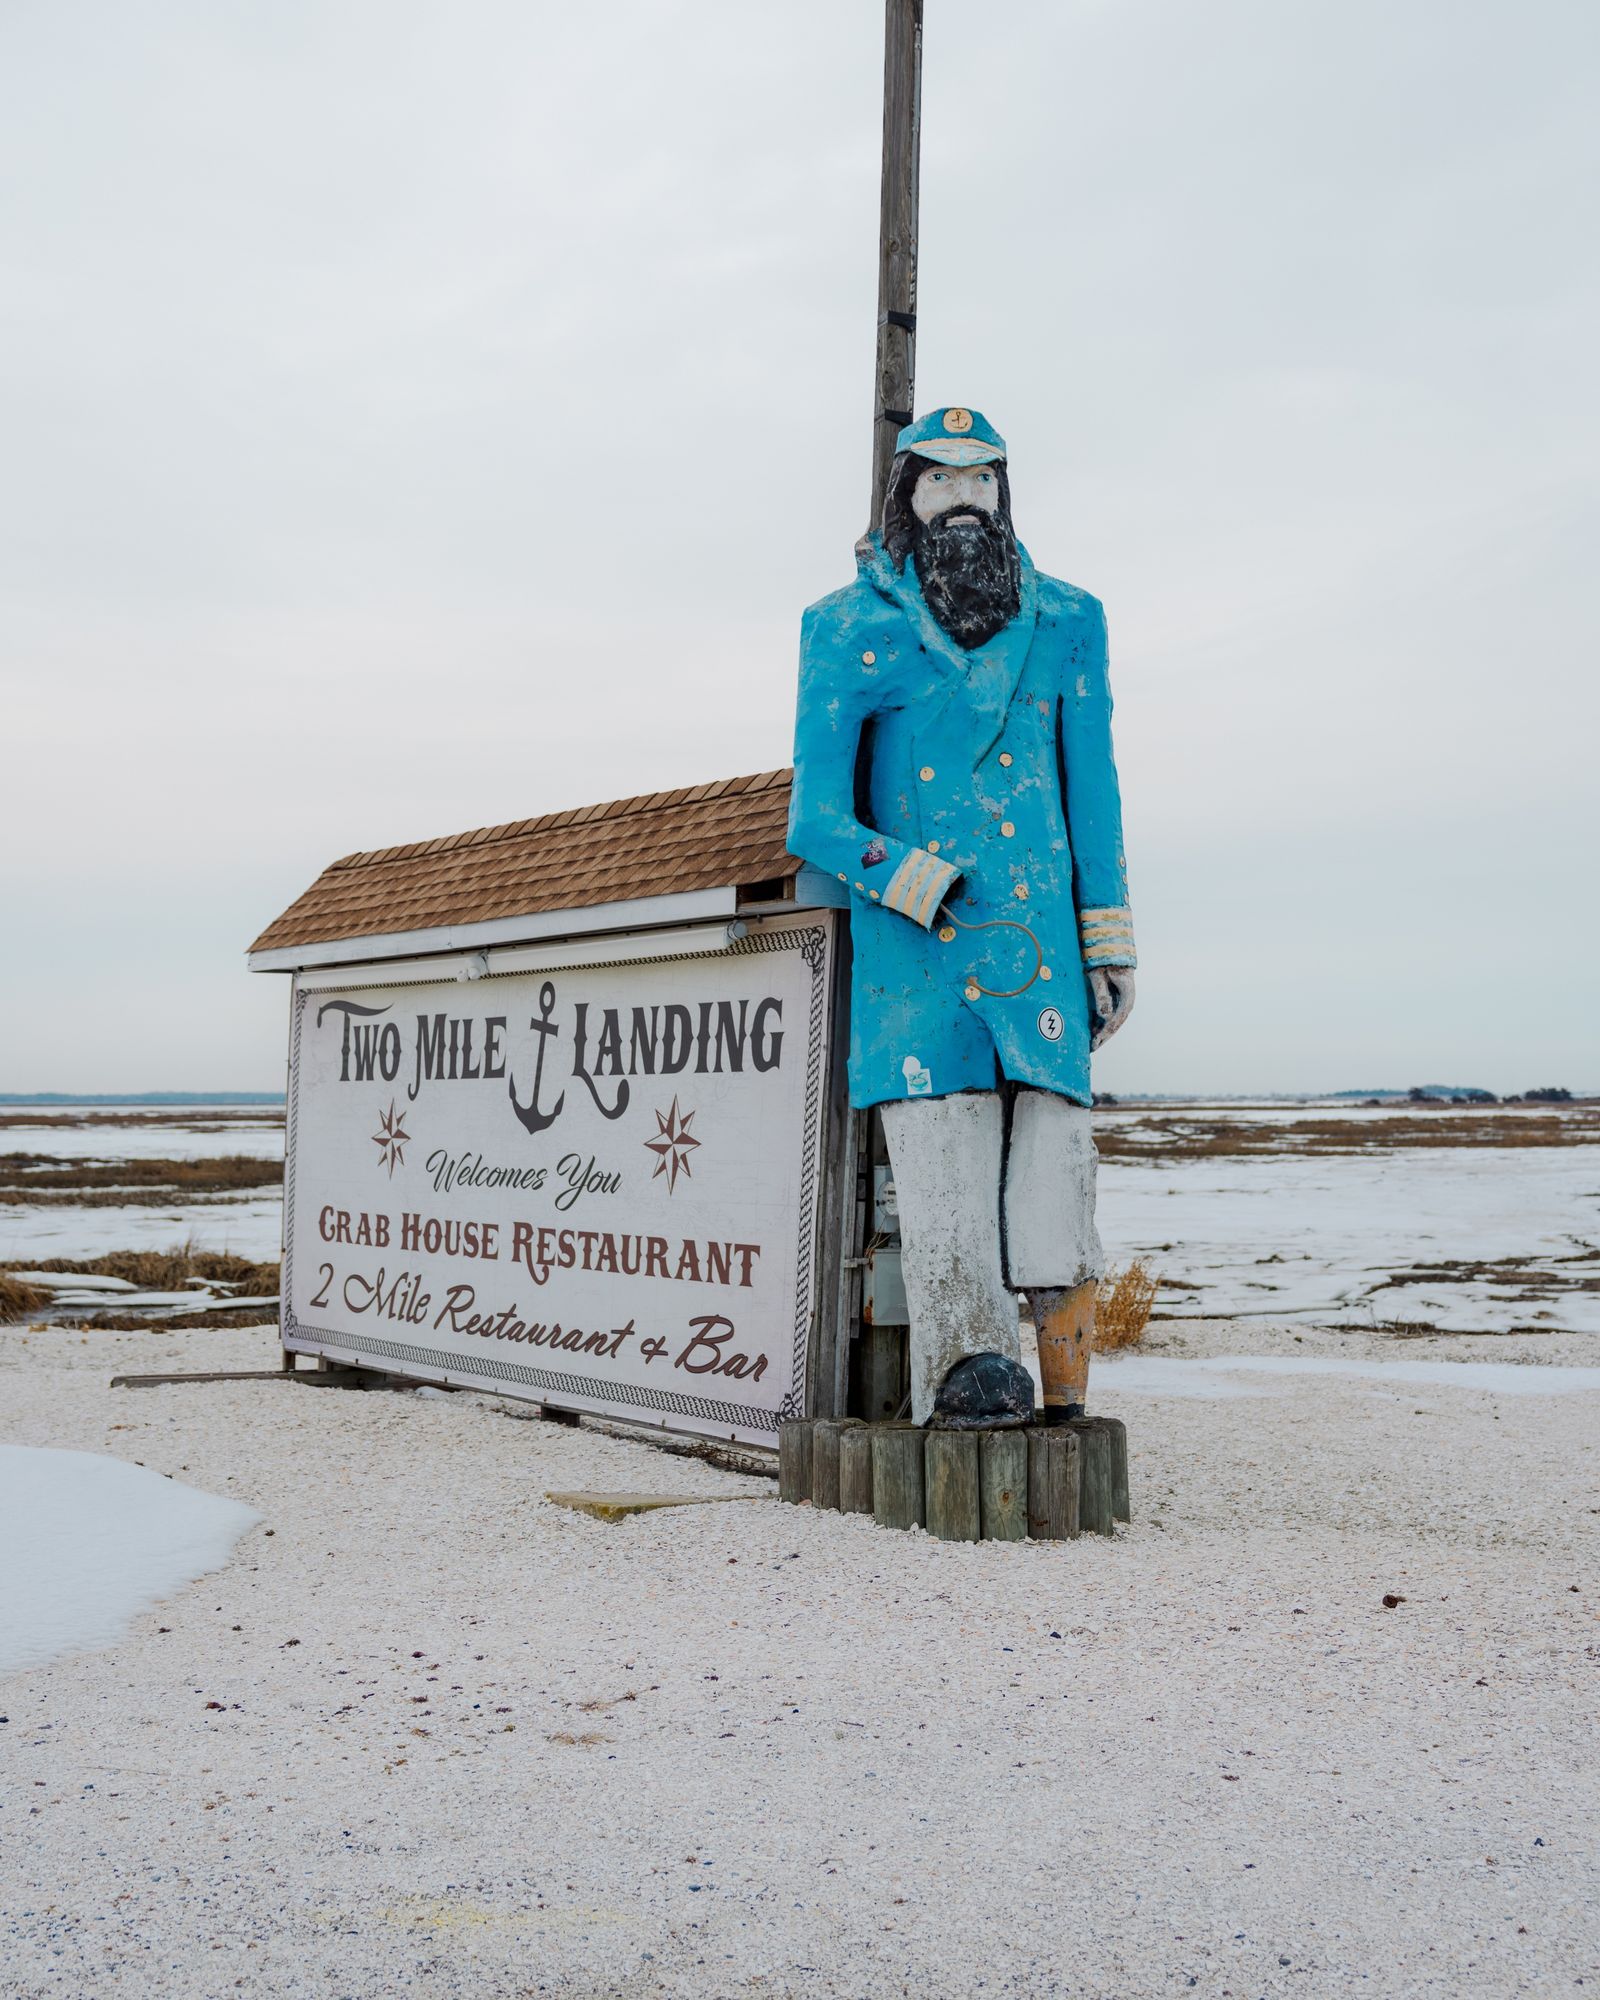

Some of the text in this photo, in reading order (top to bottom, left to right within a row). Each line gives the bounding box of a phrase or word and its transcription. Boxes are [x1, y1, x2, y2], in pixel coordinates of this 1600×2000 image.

[317, 998, 786, 1120] TWO MILE LANDING
[425, 1149, 623, 1212] Welcomes You
[317, 1205, 762, 1288] CRAB HOUSE RESTAURANT
[309, 1262, 769, 1383] 2 Mile Restaurant & Bar
